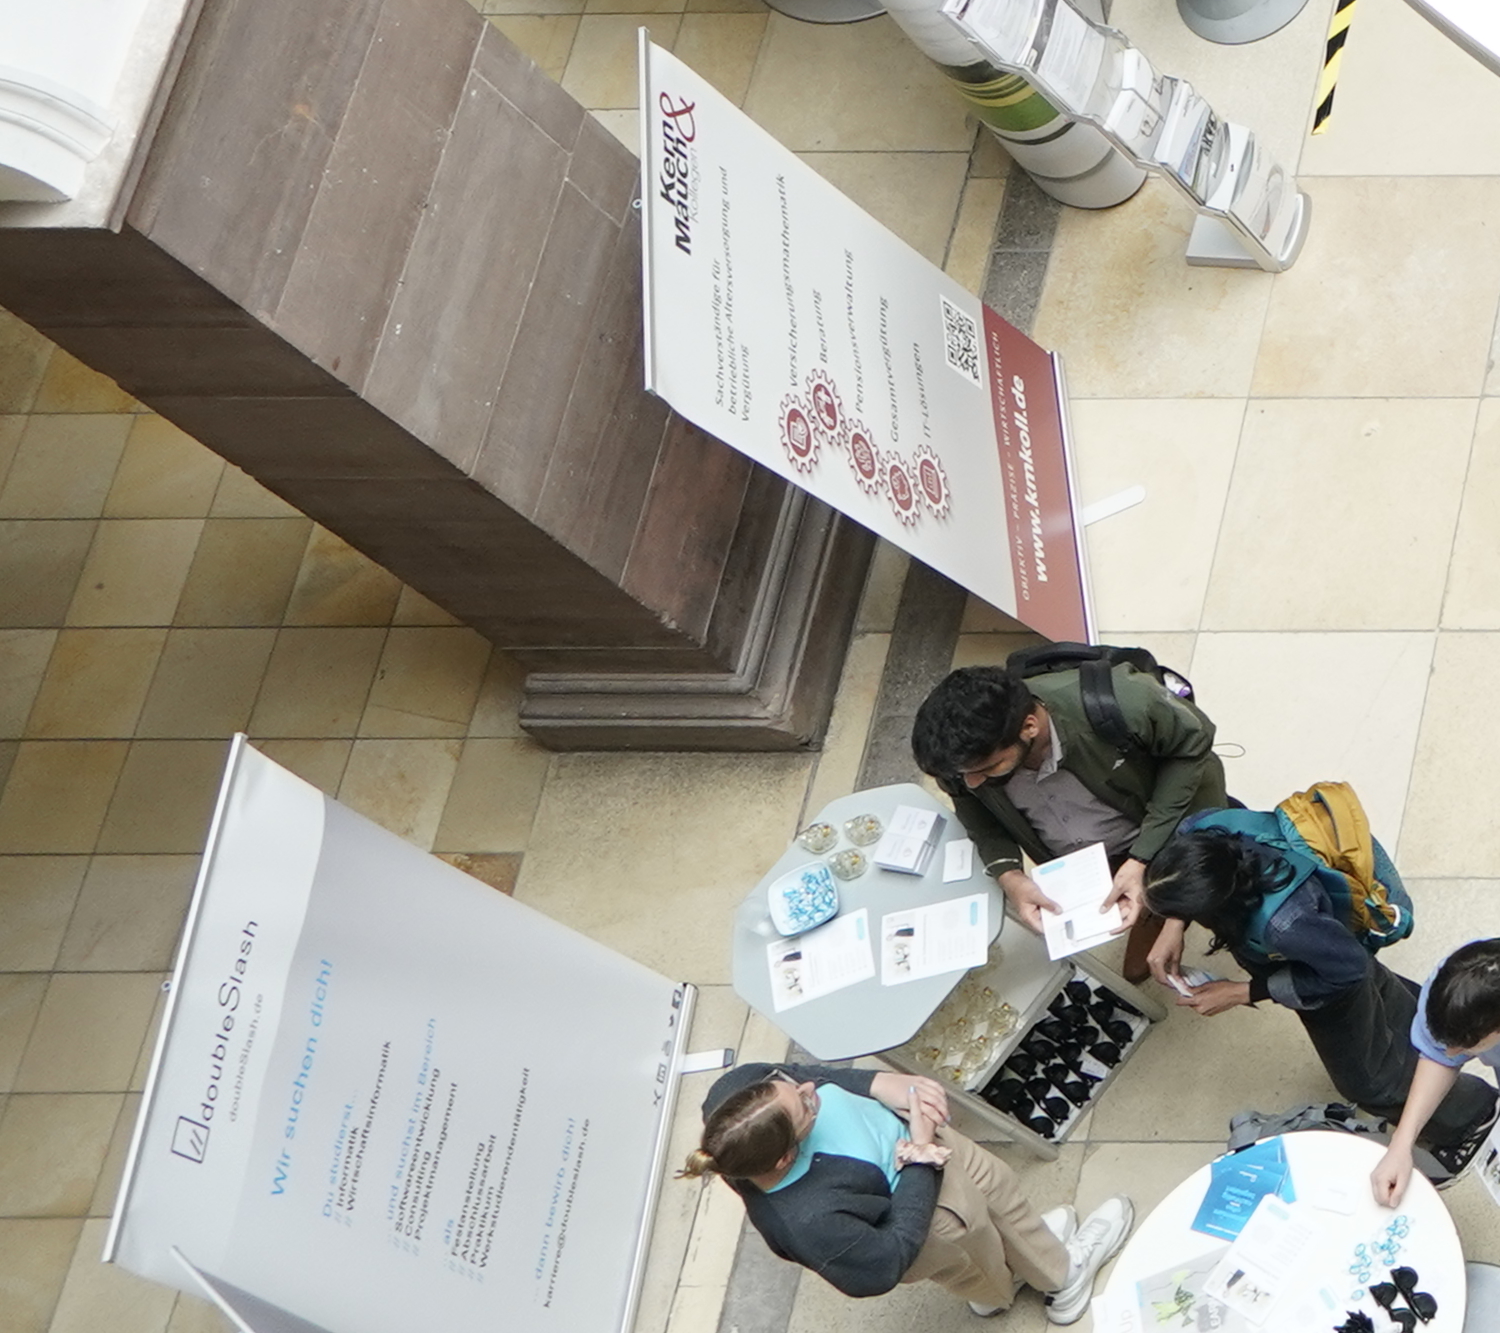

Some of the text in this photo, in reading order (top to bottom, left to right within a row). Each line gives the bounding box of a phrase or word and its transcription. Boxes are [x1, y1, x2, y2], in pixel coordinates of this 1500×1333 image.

[659, 91, 696, 207] Kern &
[674, 137, 693, 257] Mauch
[774, 172, 799, 389] Versicherungsmathematik
[812, 288, 829, 365] Beratung
[844, 248, 864, 415] Pensionsverwaltung
[1012, 374, 1050, 585] www.kmkoll.de
[200, 919, 260, 1123] doubleSlash
[229, 992, 264, 1123] doubleSlash.de
[270, 958, 334, 1198] Wir suchen dich!
[336, 1126, 360, 1209] Informatik
[346, 1039, 391, 1212] Wirtschaftsinformatik
[394, 1067, 441, 1234] Softwareentwicklung
[413, 1081, 459, 1242] Projektmanagement
[405, 1150, 433, 1238] Consulting
[451, 1142, 485, 1257] Festanstellung
[461, 1133, 498, 1263] Abschlussarbeit
[470, 1185, 495, 1266] Praktikum
